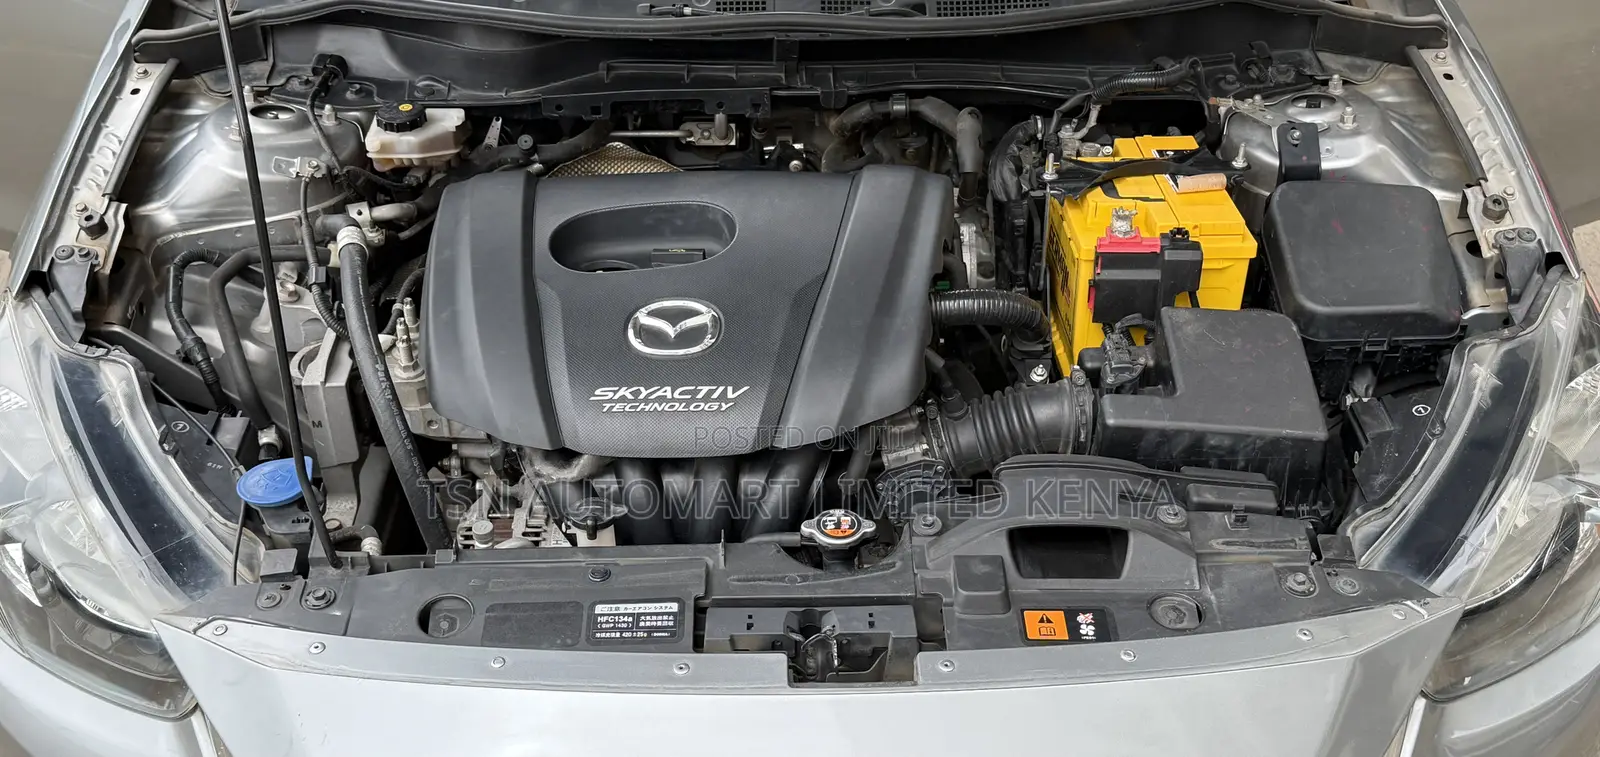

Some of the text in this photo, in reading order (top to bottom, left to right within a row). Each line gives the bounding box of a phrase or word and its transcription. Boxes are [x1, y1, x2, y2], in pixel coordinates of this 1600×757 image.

[589, 386, 750, 400] SKYACTIV
[602, 402, 735, 412] TECHNOLOGY
[312, 420, 323, 429] M
